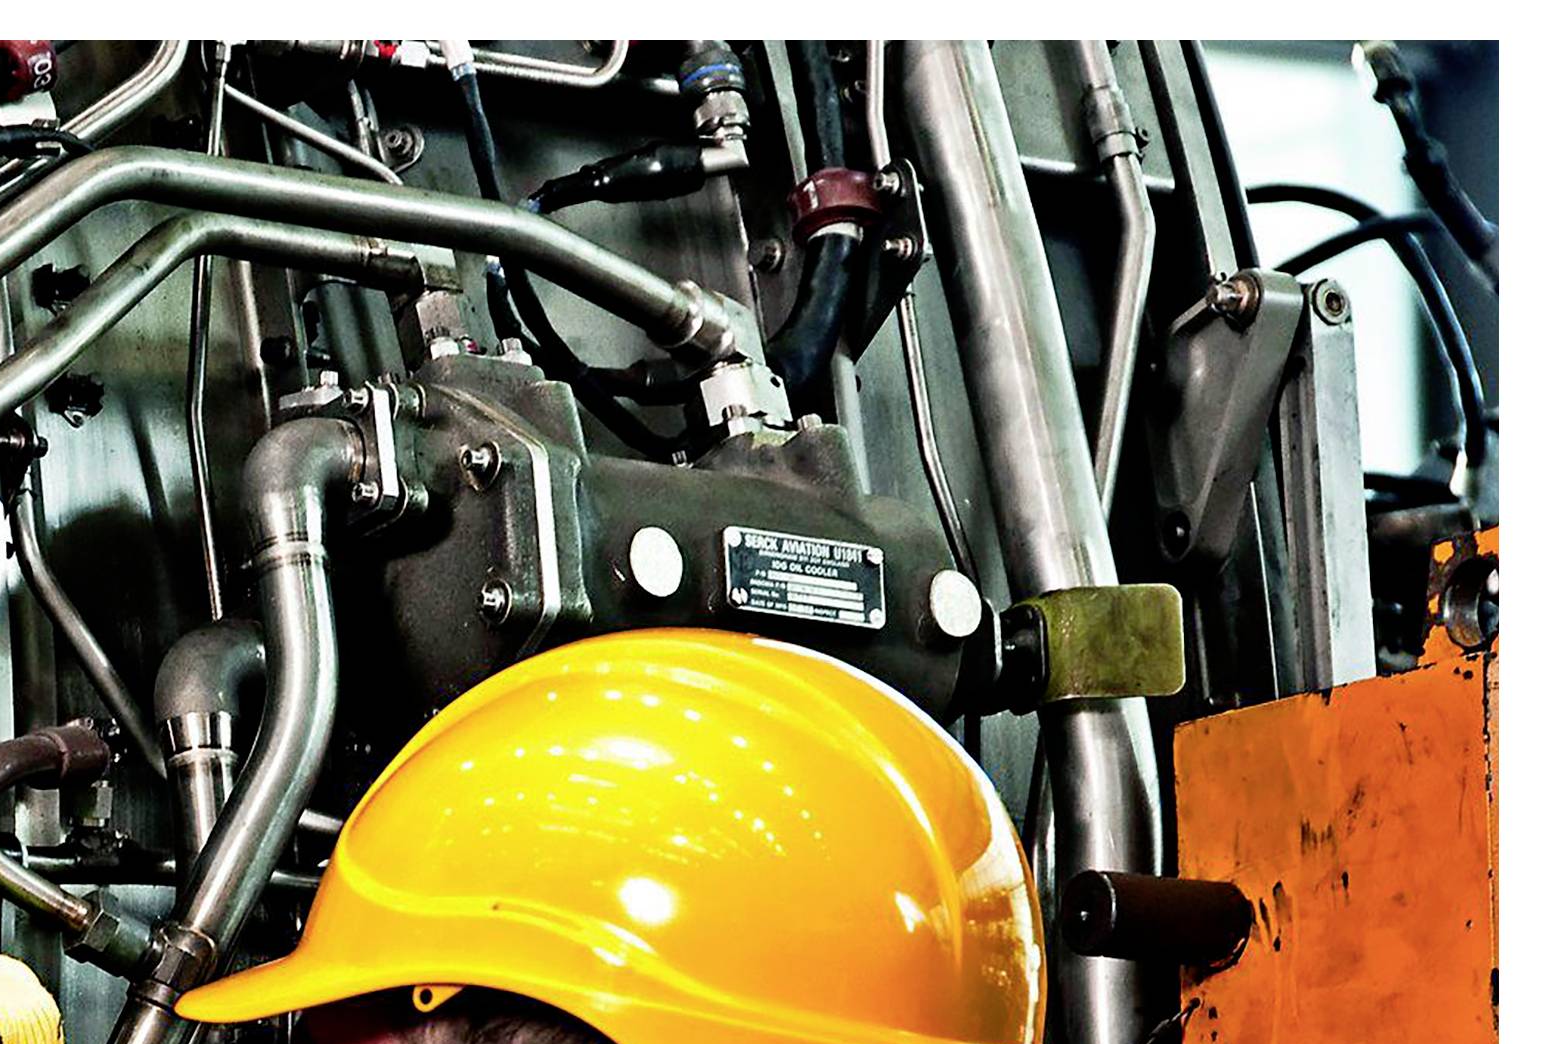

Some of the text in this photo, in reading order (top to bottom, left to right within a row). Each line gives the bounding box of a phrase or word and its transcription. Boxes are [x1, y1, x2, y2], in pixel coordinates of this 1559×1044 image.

[744, 534, 778, 551] SERCK
[782, 540, 829, 559] AVIATION
[789, 563, 803, 574] OIL
[804, 565, 838, 578] COOLER
